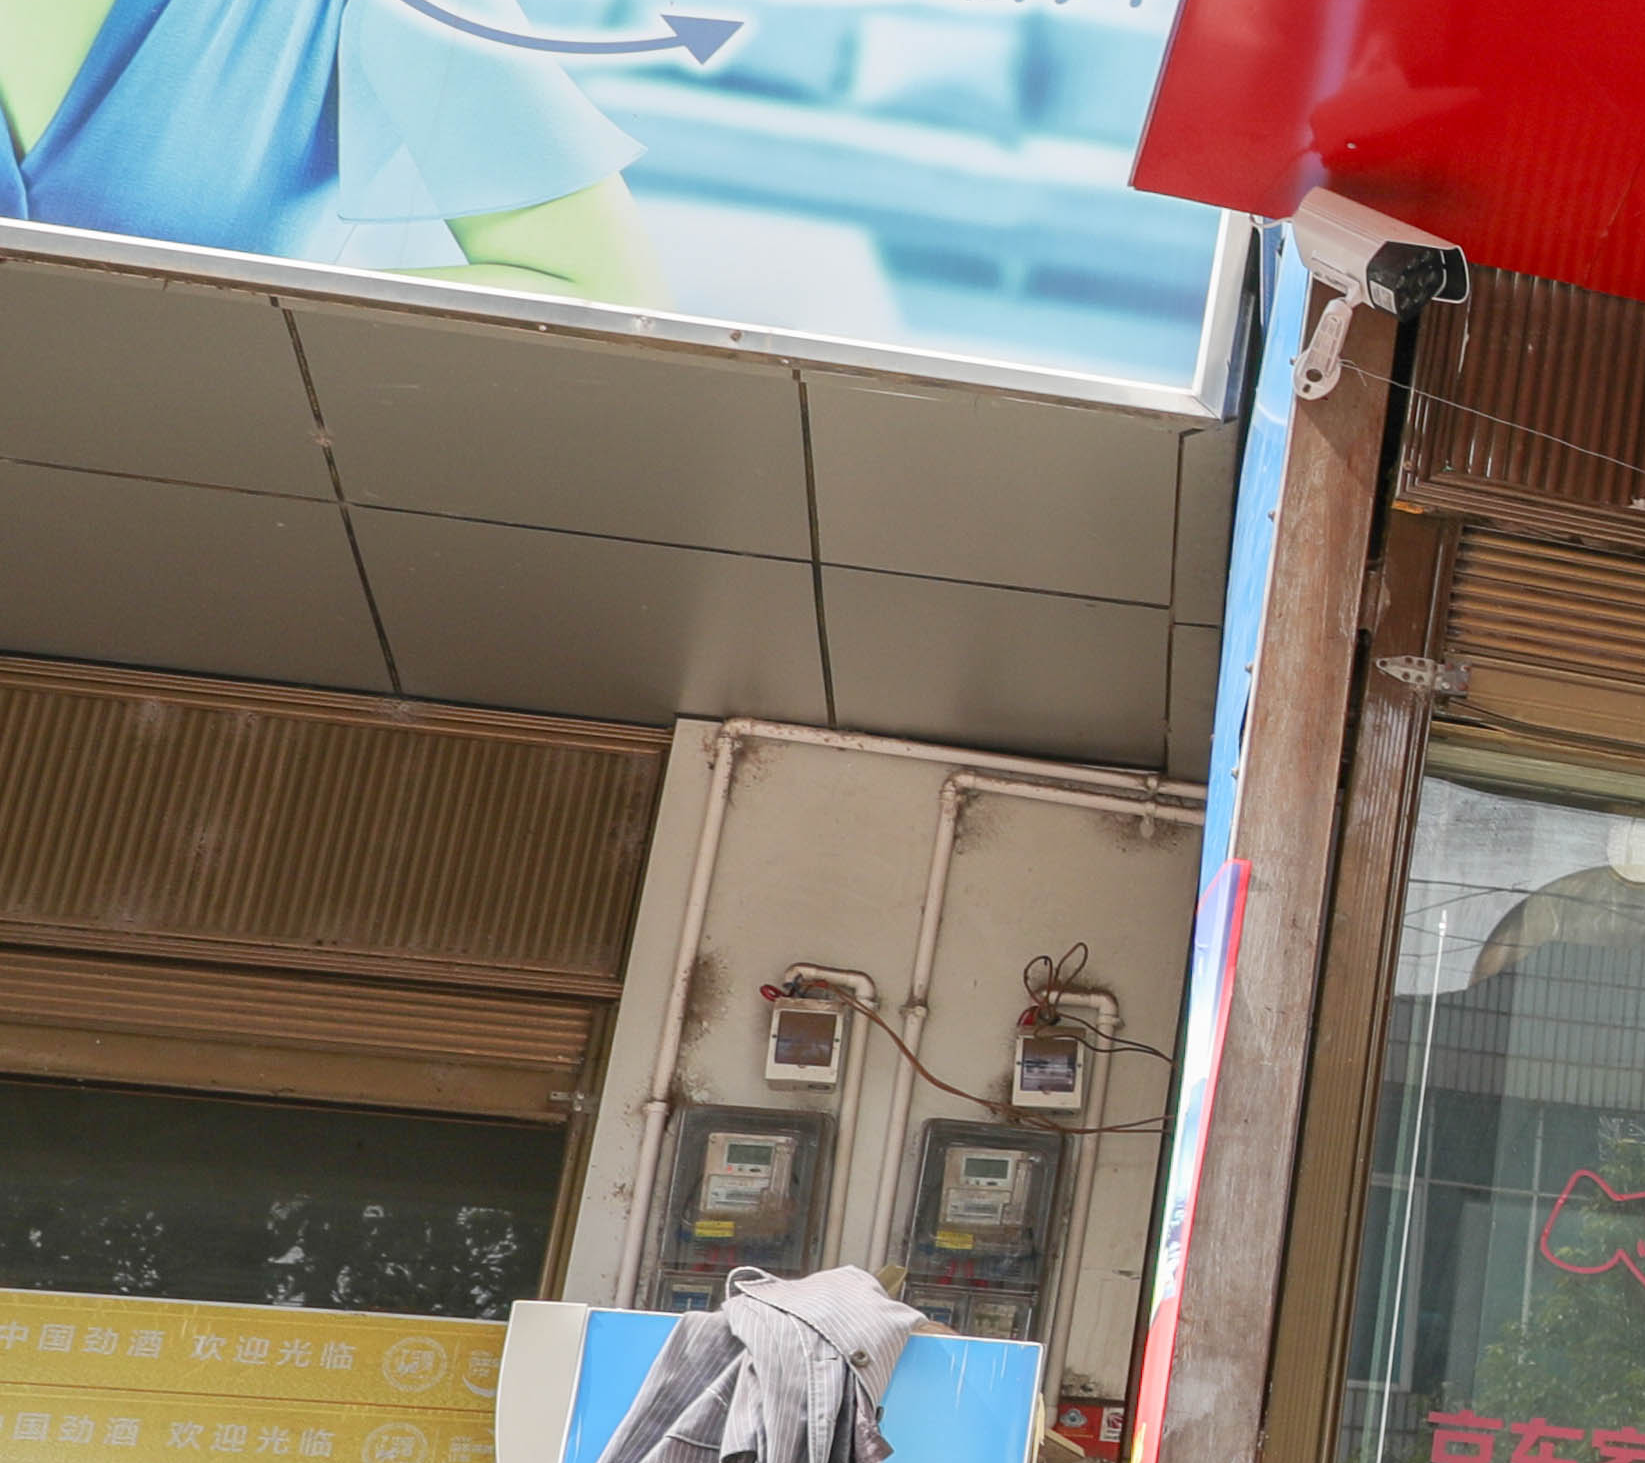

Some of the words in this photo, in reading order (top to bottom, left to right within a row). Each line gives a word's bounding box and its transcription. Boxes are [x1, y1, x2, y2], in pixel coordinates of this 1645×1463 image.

[190, 1334, 358, 1372] 欢迎光临
[166, 1420, 336, 1460] 欢迎光临
